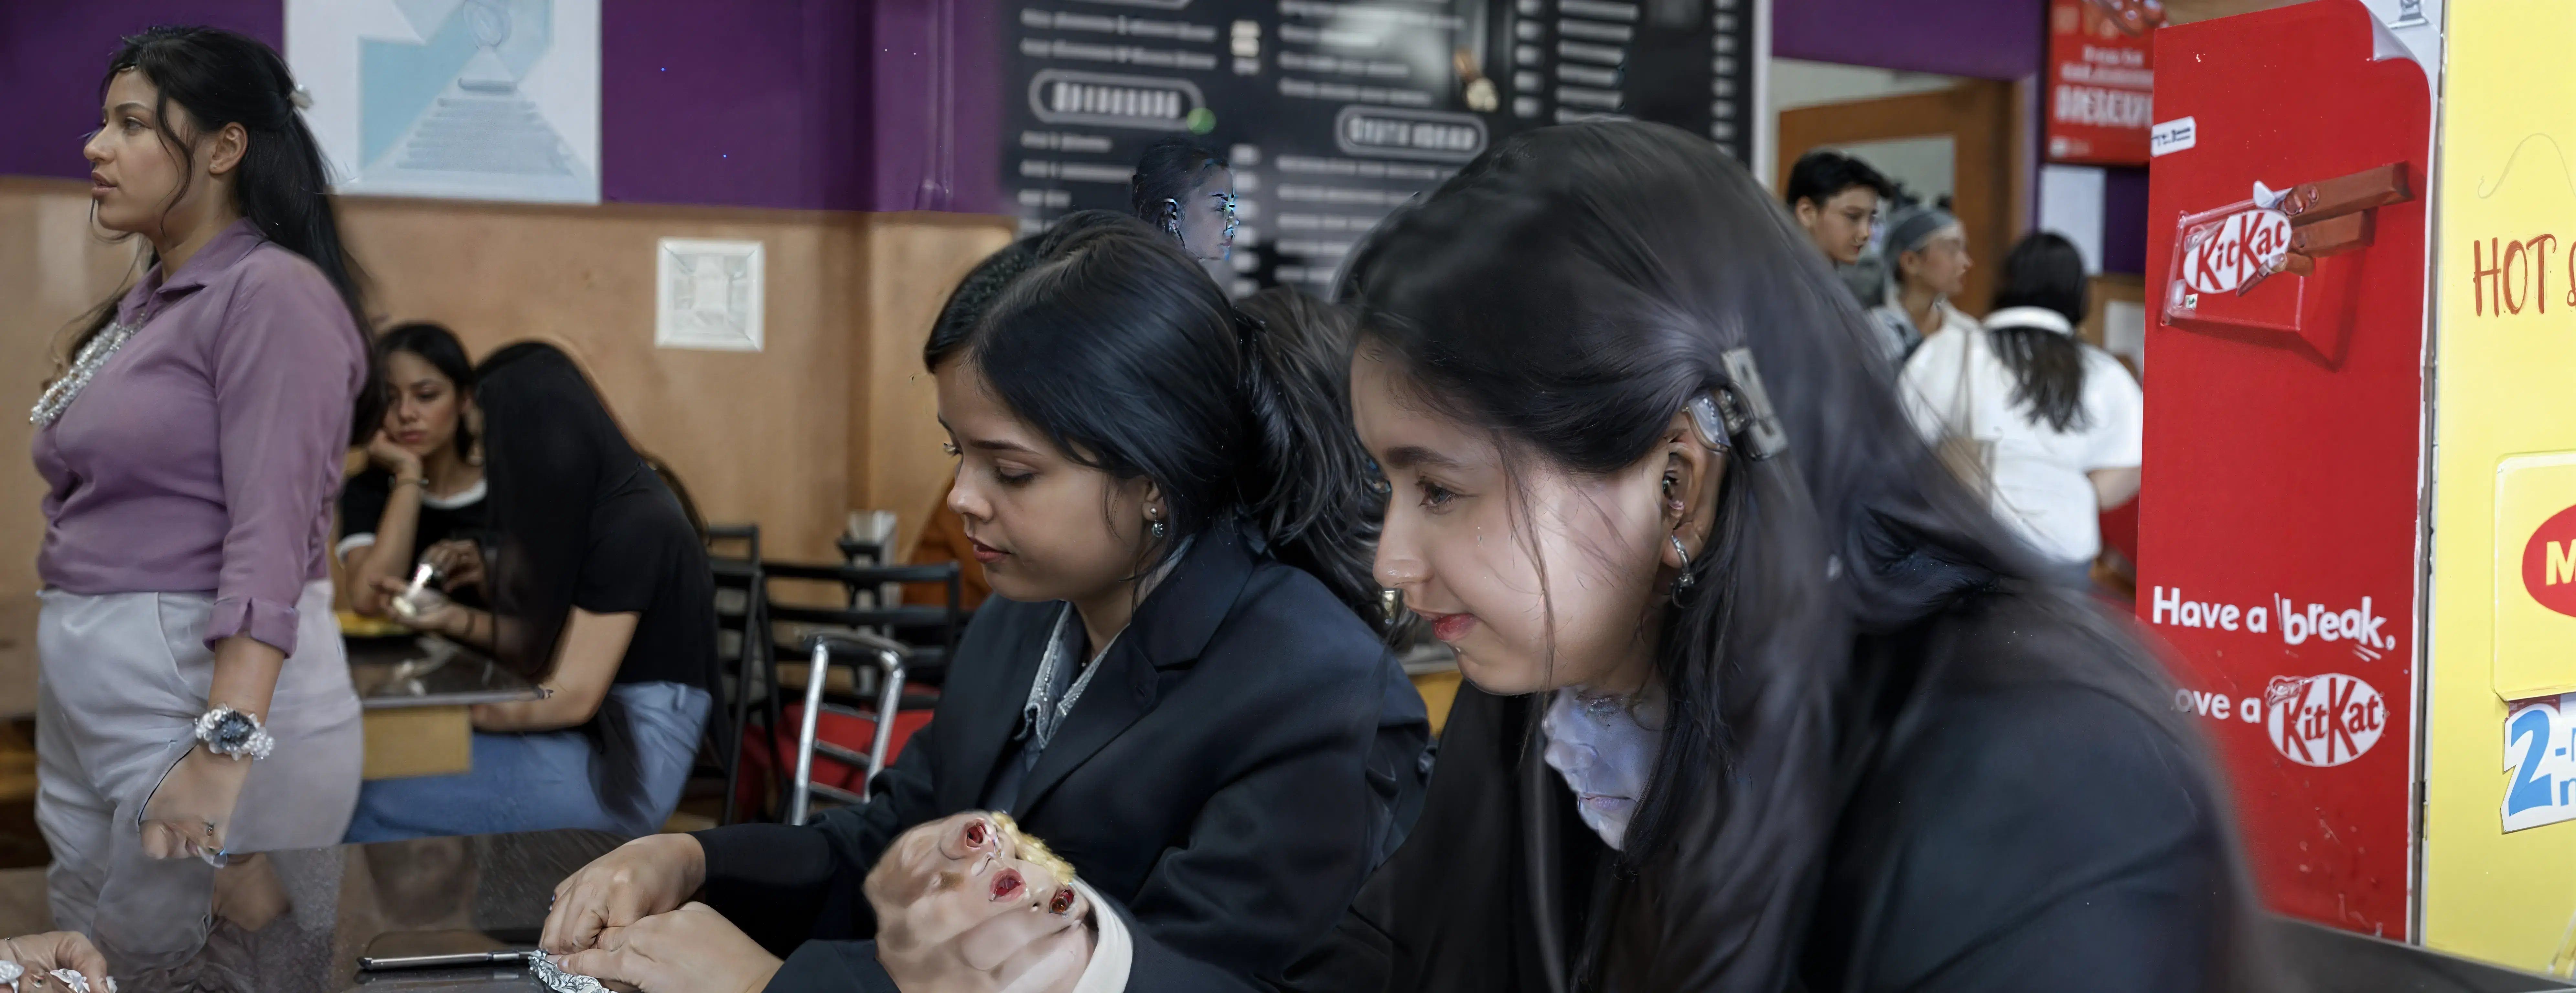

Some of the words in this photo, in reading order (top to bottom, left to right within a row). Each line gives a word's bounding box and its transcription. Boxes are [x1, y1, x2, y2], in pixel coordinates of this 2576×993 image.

[2473, 233, 2557, 318] HOT
[2152, 585, 2240, 631] Have
[2246, 606, 2268, 634] a
[2173, 688, 2231, 720] ove
[2240, 697, 2261, 724] a
[2282, 678, 2380, 764] KitKat
